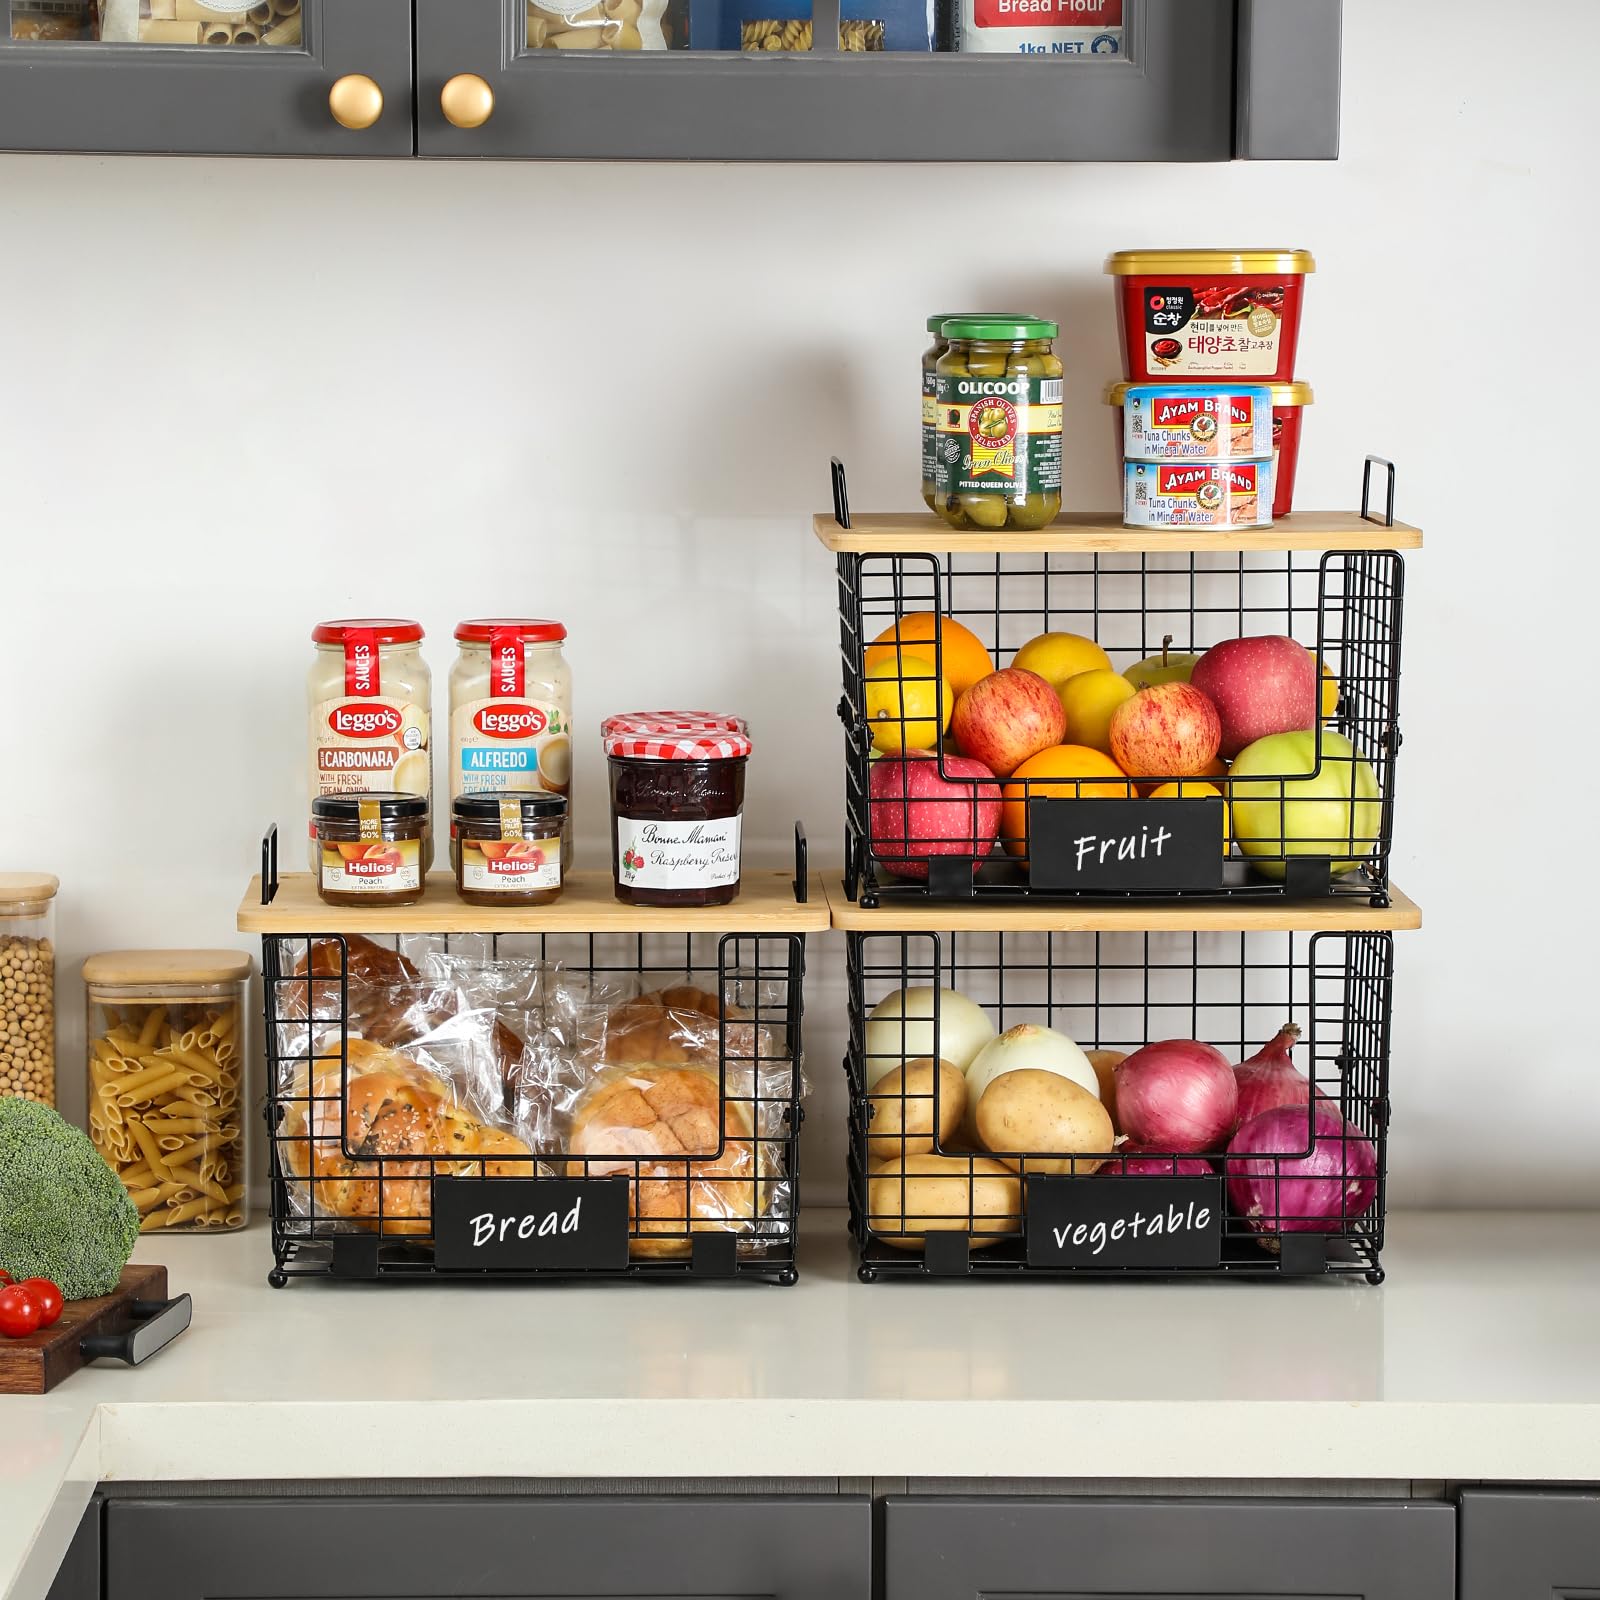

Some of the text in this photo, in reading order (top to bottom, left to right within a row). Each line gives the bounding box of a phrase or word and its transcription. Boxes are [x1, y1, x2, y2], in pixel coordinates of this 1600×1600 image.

[1052, 42, 1084, 53] NET
[1153, 312, 1182, 326] 순창
[971, 399, 1017, 424] SPANISH OLIVES
[1159, 400, 1199, 423] AYAM
[974, 433, 1012, 448] SELECTED
[1144, 430, 1160, 441] Tuna
[1161, 430, 1191, 442] Chunks
[1144, 444, 1207, 455] in Mineral Water
[1165, 469, 1206, 490] AYAM
[1149, 498, 1166, 509] Tuna
[1167, 498, 1197, 509] Chunks
[1149, 511, 1213, 523] in Mineral Water
[355, 645, 370, 690] SAUCES
[501, 647, 516, 692] SAUCES
[325, 750, 394, 768] CARBONARA
[470, 751, 527, 768] ALFREDO
[337, 774, 362, 785] FRESH
[481, 774, 506, 785] FRESH
[361, 831, 379, 839] 60%
[641, 824, 680, 844] Bonne
[1073, 825, 1172, 871] Fruit
[348, 862, 393, 873] Helios
[491, 861, 536, 871] Helios
[650, 850, 709, 871] Raspberry
[358, 877, 382, 885] Peach
[469, 1196, 582, 1247] Bread
[1053, 1201, 1211, 1255] vegetable
